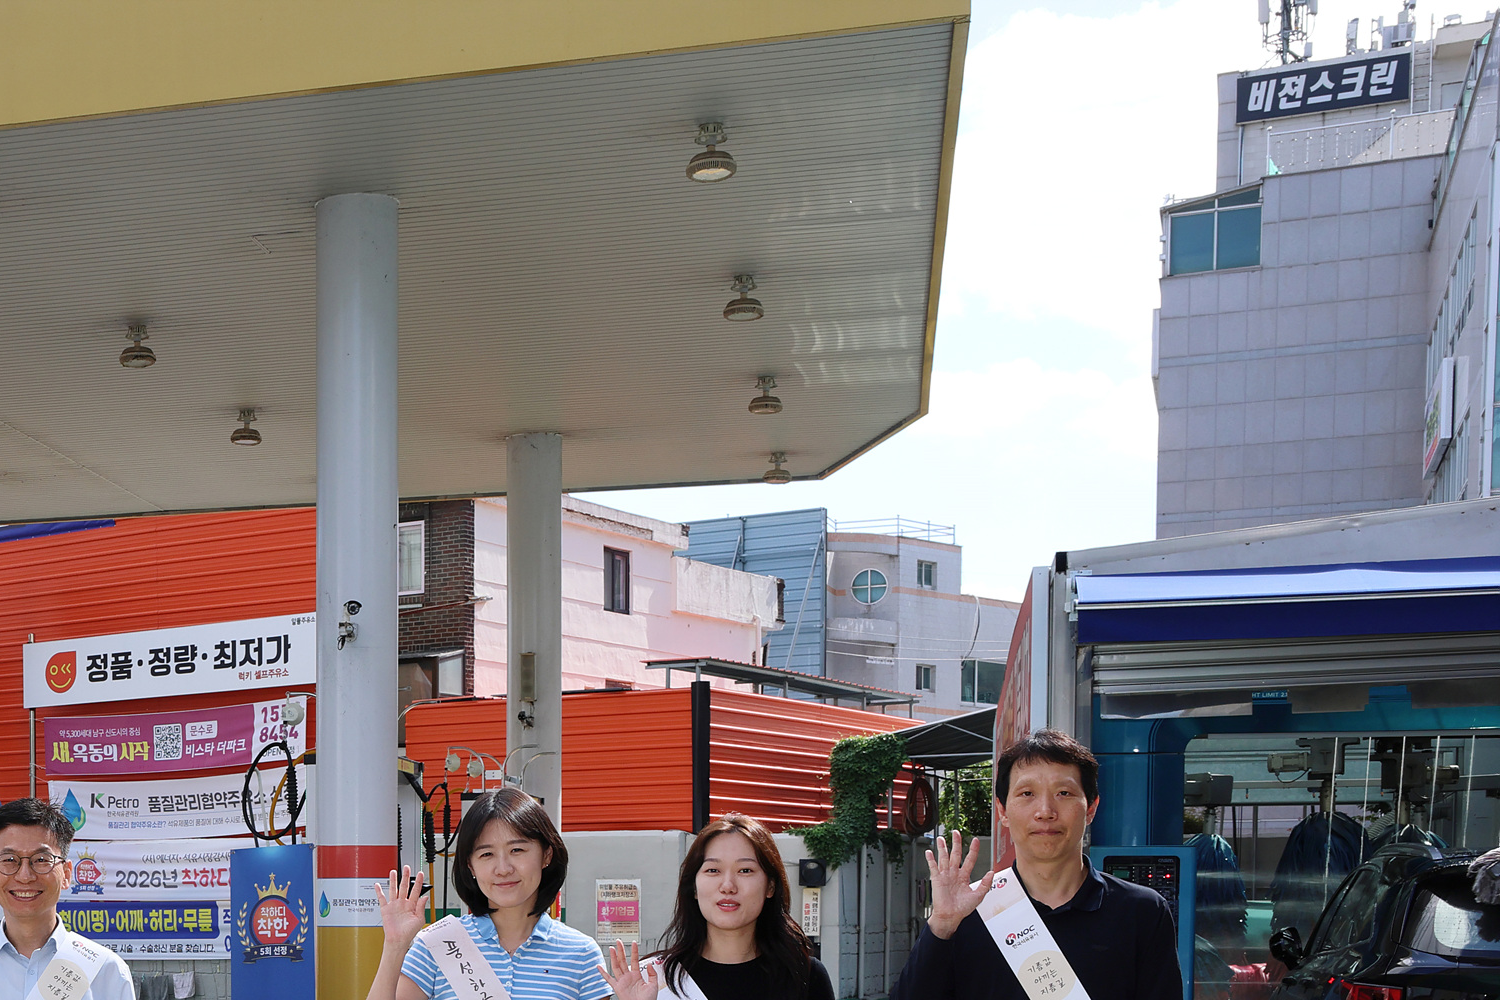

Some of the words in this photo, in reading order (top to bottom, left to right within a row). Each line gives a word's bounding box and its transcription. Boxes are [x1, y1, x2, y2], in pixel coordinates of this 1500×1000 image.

[1248, 60, 1398, 113] 비젼스크린
[238, 671, 252, 681] 럭키
[254, 668, 289, 680] 셀프주유소
[66, 729, 91, 738] 5,300세대
[93, 728, 104, 738] 남구
[105, 727, 128, 738] 신도시의
[129, 726, 141, 736] 중심
[190, 724, 213, 737] 문수로
[120, 741, 150, 761] 시작
[185, 742, 215, 758] 비스타
[217, 739, 246, 755] 더파크
[79, 871, 96, 882] 착한
[116, 868, 178, 889] 2026년
[261, 906, 285, 917] 착하디
[601, 906, 635, 916] 화기엄금
[257, 917, 289, 938] 착한
[1005, 924, 1036, 946] KNOC
[120, 944, 133, 953] 시술
[139, 944, 168, 953] 수술하신
[169, 944, 184, 953] 분을
[185, 944, 215, 953] 찾습니다.
[260, 946, 271, 956] 5회
[273, 946, 287, 956] 선정
[53, 975, 74, 991] 아끼는
[1034, 968, 1058, 984] 아끼는
[1041, 978, 1066, 995] 지름길
